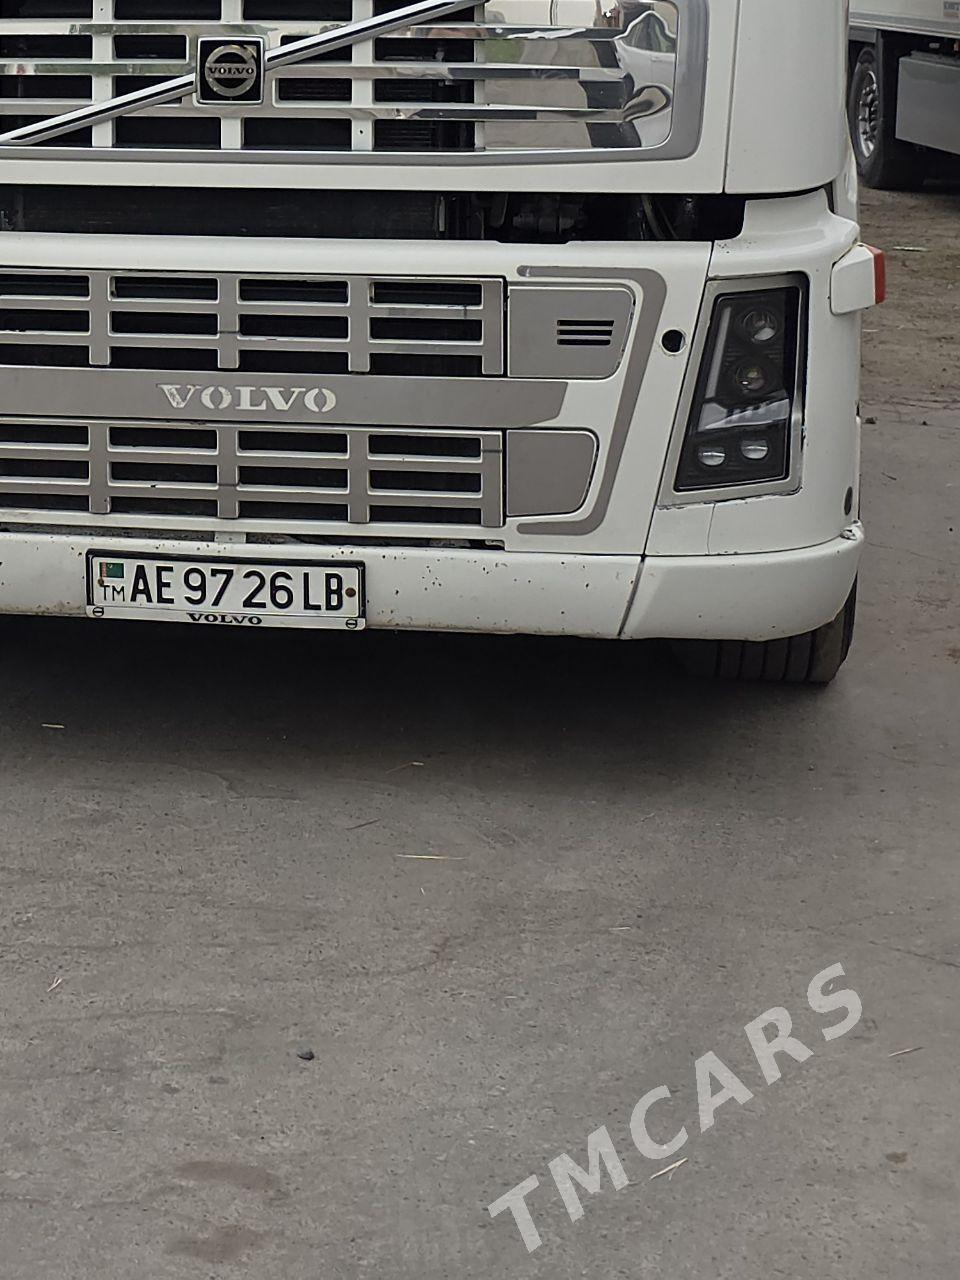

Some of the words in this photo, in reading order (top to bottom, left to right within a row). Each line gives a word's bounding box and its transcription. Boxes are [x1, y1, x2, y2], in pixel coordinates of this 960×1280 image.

[208, 66, 255, 75] VOLVO
[157, 383, 337, 413] VOLVO
[102, 584, 126, 603] TM
[186, 612, 263, 626] VOLVO
